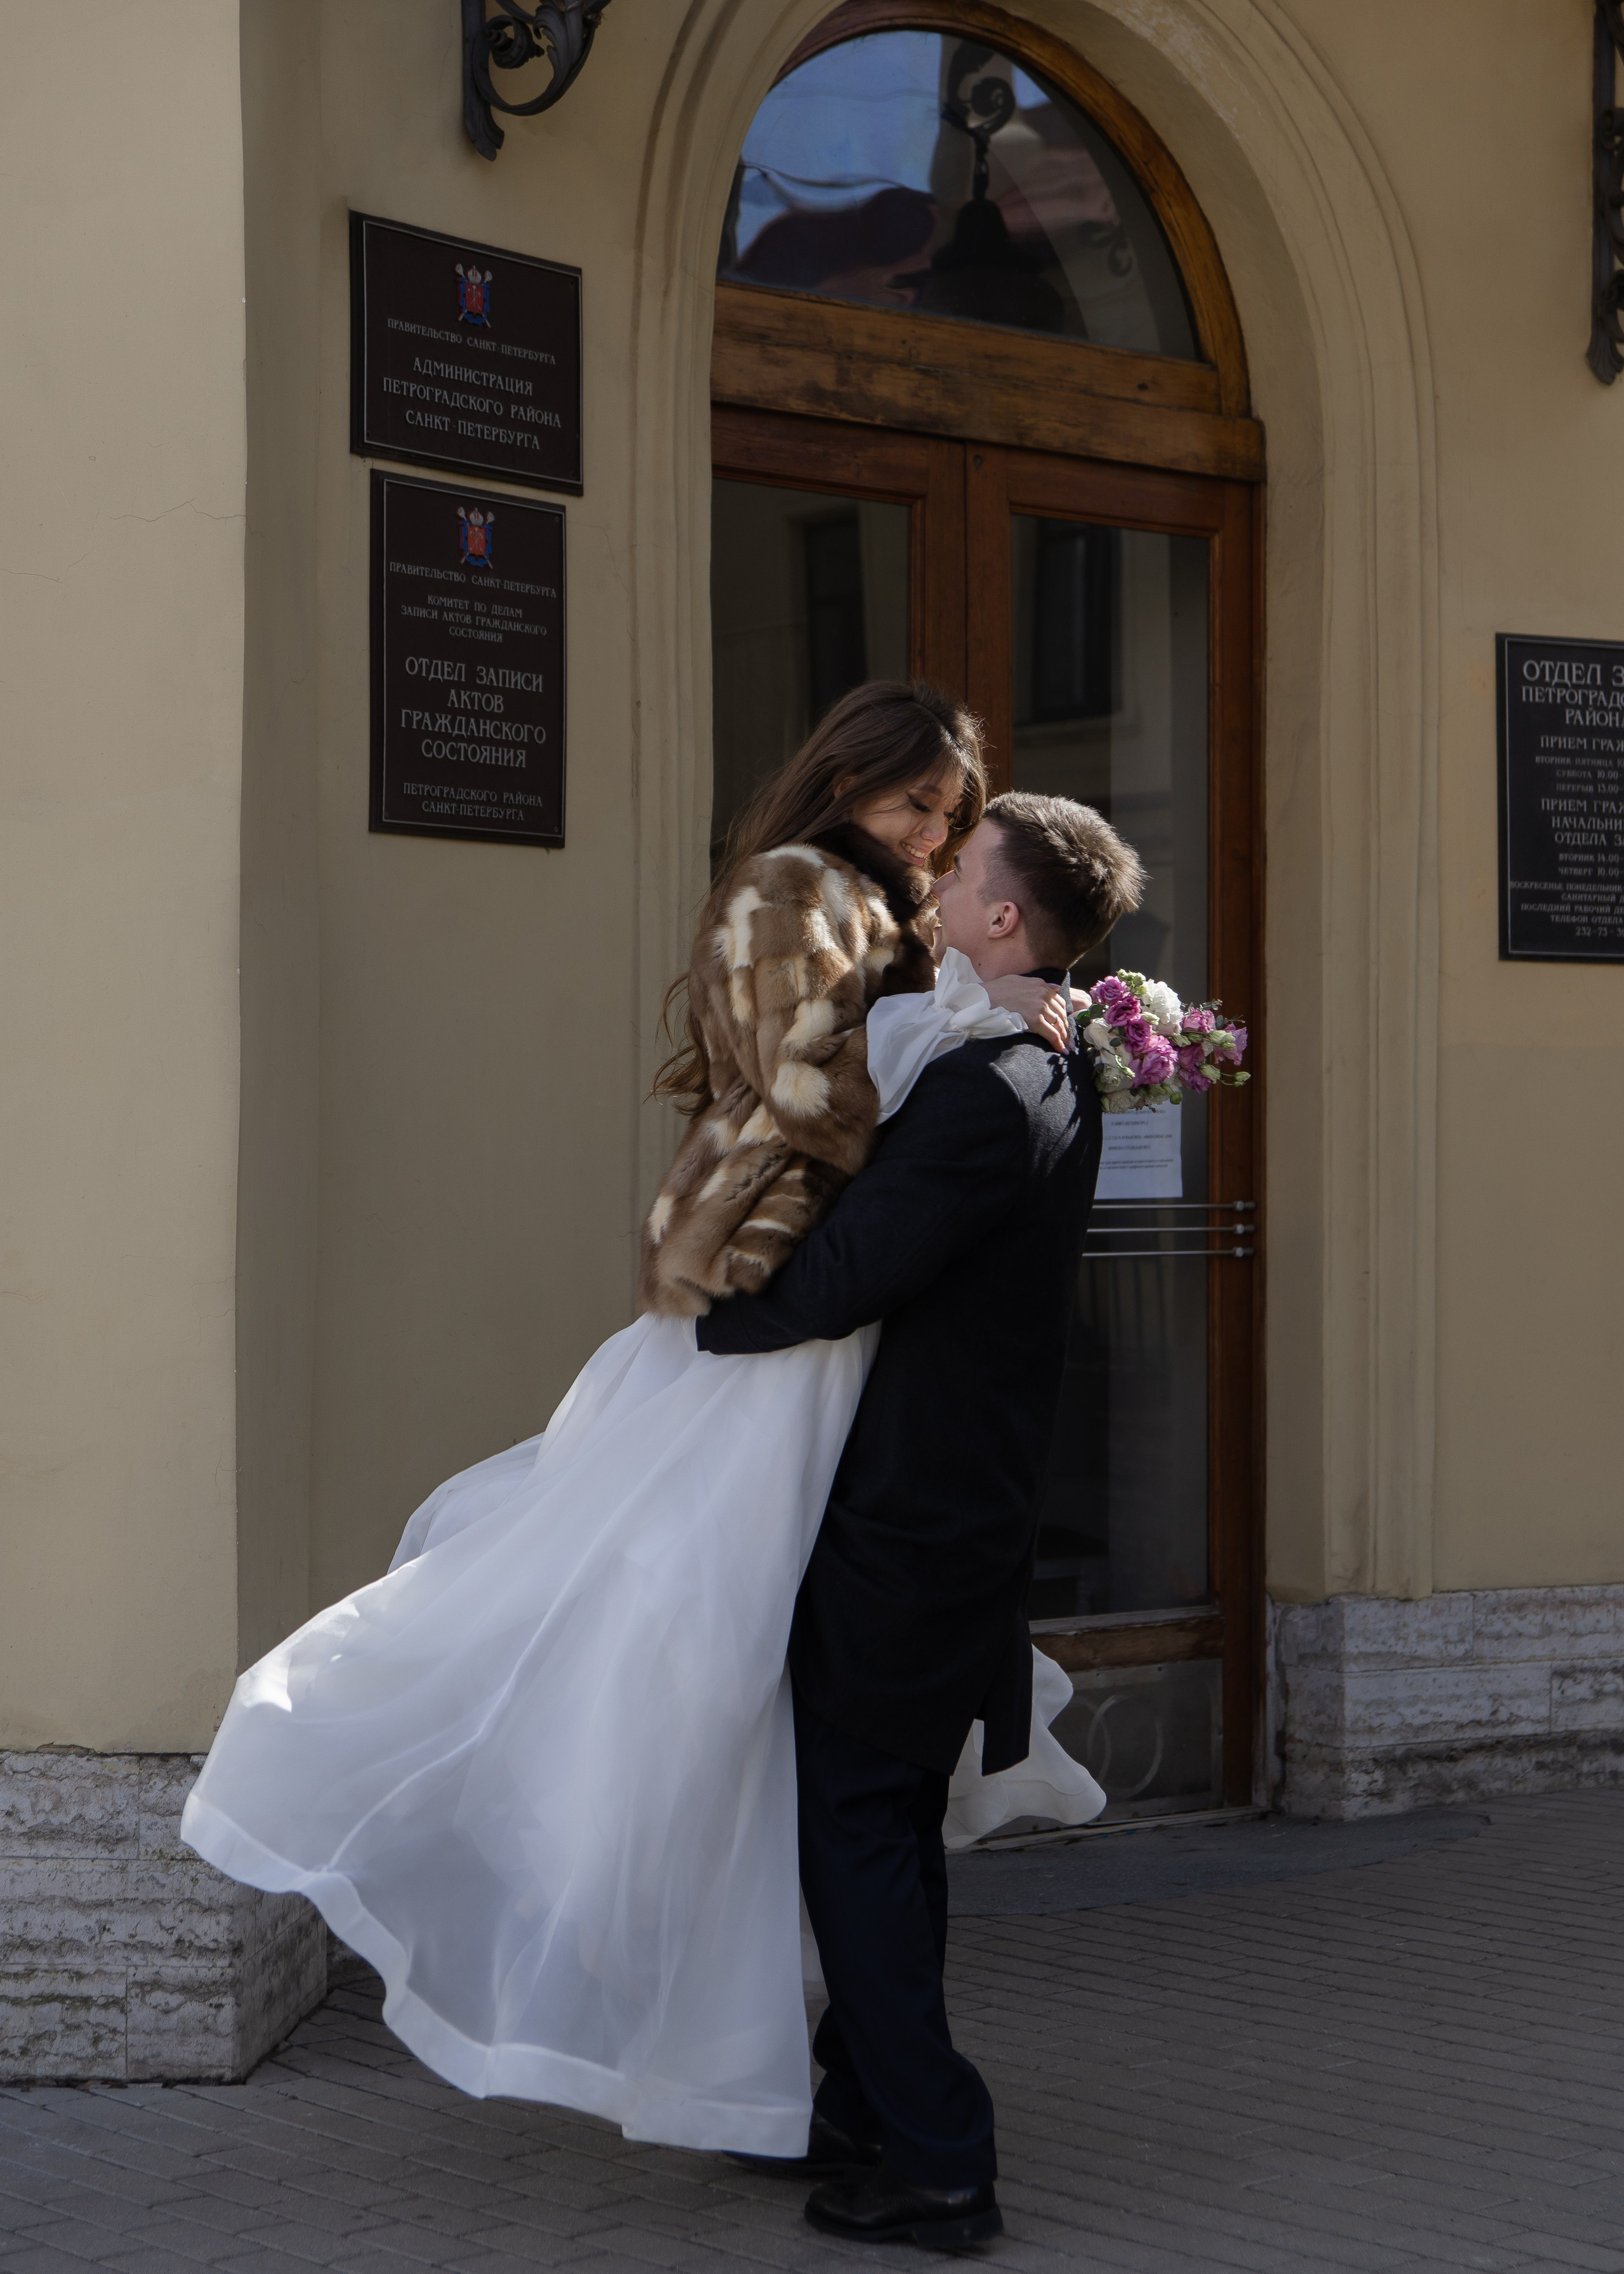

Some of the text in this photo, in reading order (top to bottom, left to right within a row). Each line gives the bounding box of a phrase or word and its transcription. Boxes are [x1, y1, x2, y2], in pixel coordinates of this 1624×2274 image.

[388, 318, 556, 365] ПРАВИТЕЛЬСТВО САНКТ-ПЕТЕРБУРГА
[413, 357, 533, 396] АДМИНИСТРАЦИЯ
[383, 377, 561, 428] ПЕТРОГРАДСКОГО РАЙОНА
[405, 410, 540, 450] САНКТ-ПЕТЕРБУРГА
[390, 562, 556, 598] ПРАВИТЕЛЬСТВО САНКТ-ПЕТЕРБУРГА
[428, 595, 523, 618] КОМИТЕТ ПО ДЕЛАМ
[401, 605, 547, 636] ЗАПИСИ АКТОВ ГРАЖДАНСКОГО
[449, 626, 503, 643] СОСТОЯНИЯ
[405, 656, 543, 692] ОТДЕЛ ЗАПИСИ
[1522, 660, 1602, 688] ОТДЕЛ
[447, 688, 504, 713] АКТОВ
[400, 709, 546, 744] ГРАЖДАНСКОГО
[421, 739, 527, 768] СОСТОЯНИЯ
[1540, 735, 1587, 750] ПРИЕМ
[1535, 755, 1571, 765] ВТОРНИК
[403, 782, 543, 806] ПЕТРОГРАДСКОГО РАЙОНА
[1542, 798, 1587, 813] ПРИЕМ
[422, 801, 525, 821] САНКТ-ПЕТЕРБУРГА
[1552, 815, 1624, 831] НАЧАЛЬНИ
[1554, 832, 1608, 848] ОТДЕЛА
[1558, 852, 1595, 862] ВТОРНИК
[1558, 867, 1594, 877] ЧЕТВЕРГ
[1521, 902, 1571, 912] ПОСЛЕДНИЙ
[1574, 904, 1611, 914] РАБОЧИЙ
[1561, 893, 1616, 903] САНИТАРНЫЙ
[1550, 914, 1623, 924] ТЕЛЕФОН ОТДЕЛА
